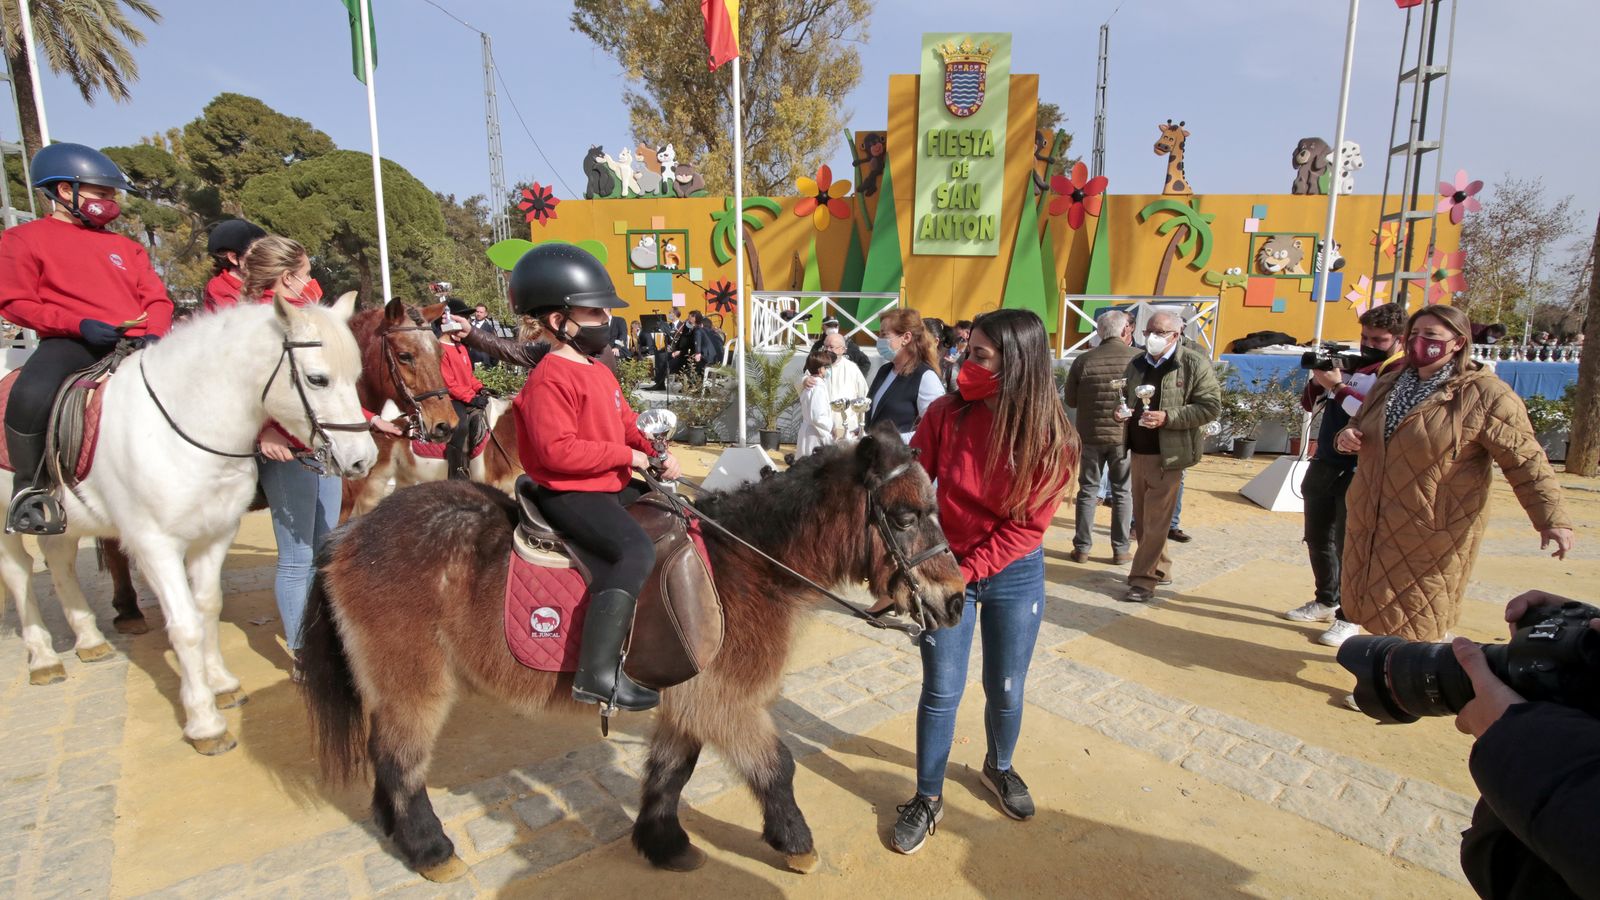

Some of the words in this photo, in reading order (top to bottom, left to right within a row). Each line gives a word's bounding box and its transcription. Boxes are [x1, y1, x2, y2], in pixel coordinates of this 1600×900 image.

[927, 129, 994, 157] FIESTA
[951, 160, 970, 179] DE
[937, 182, 981, 209] SAN
[920, 213, 995, 240] ANTON
